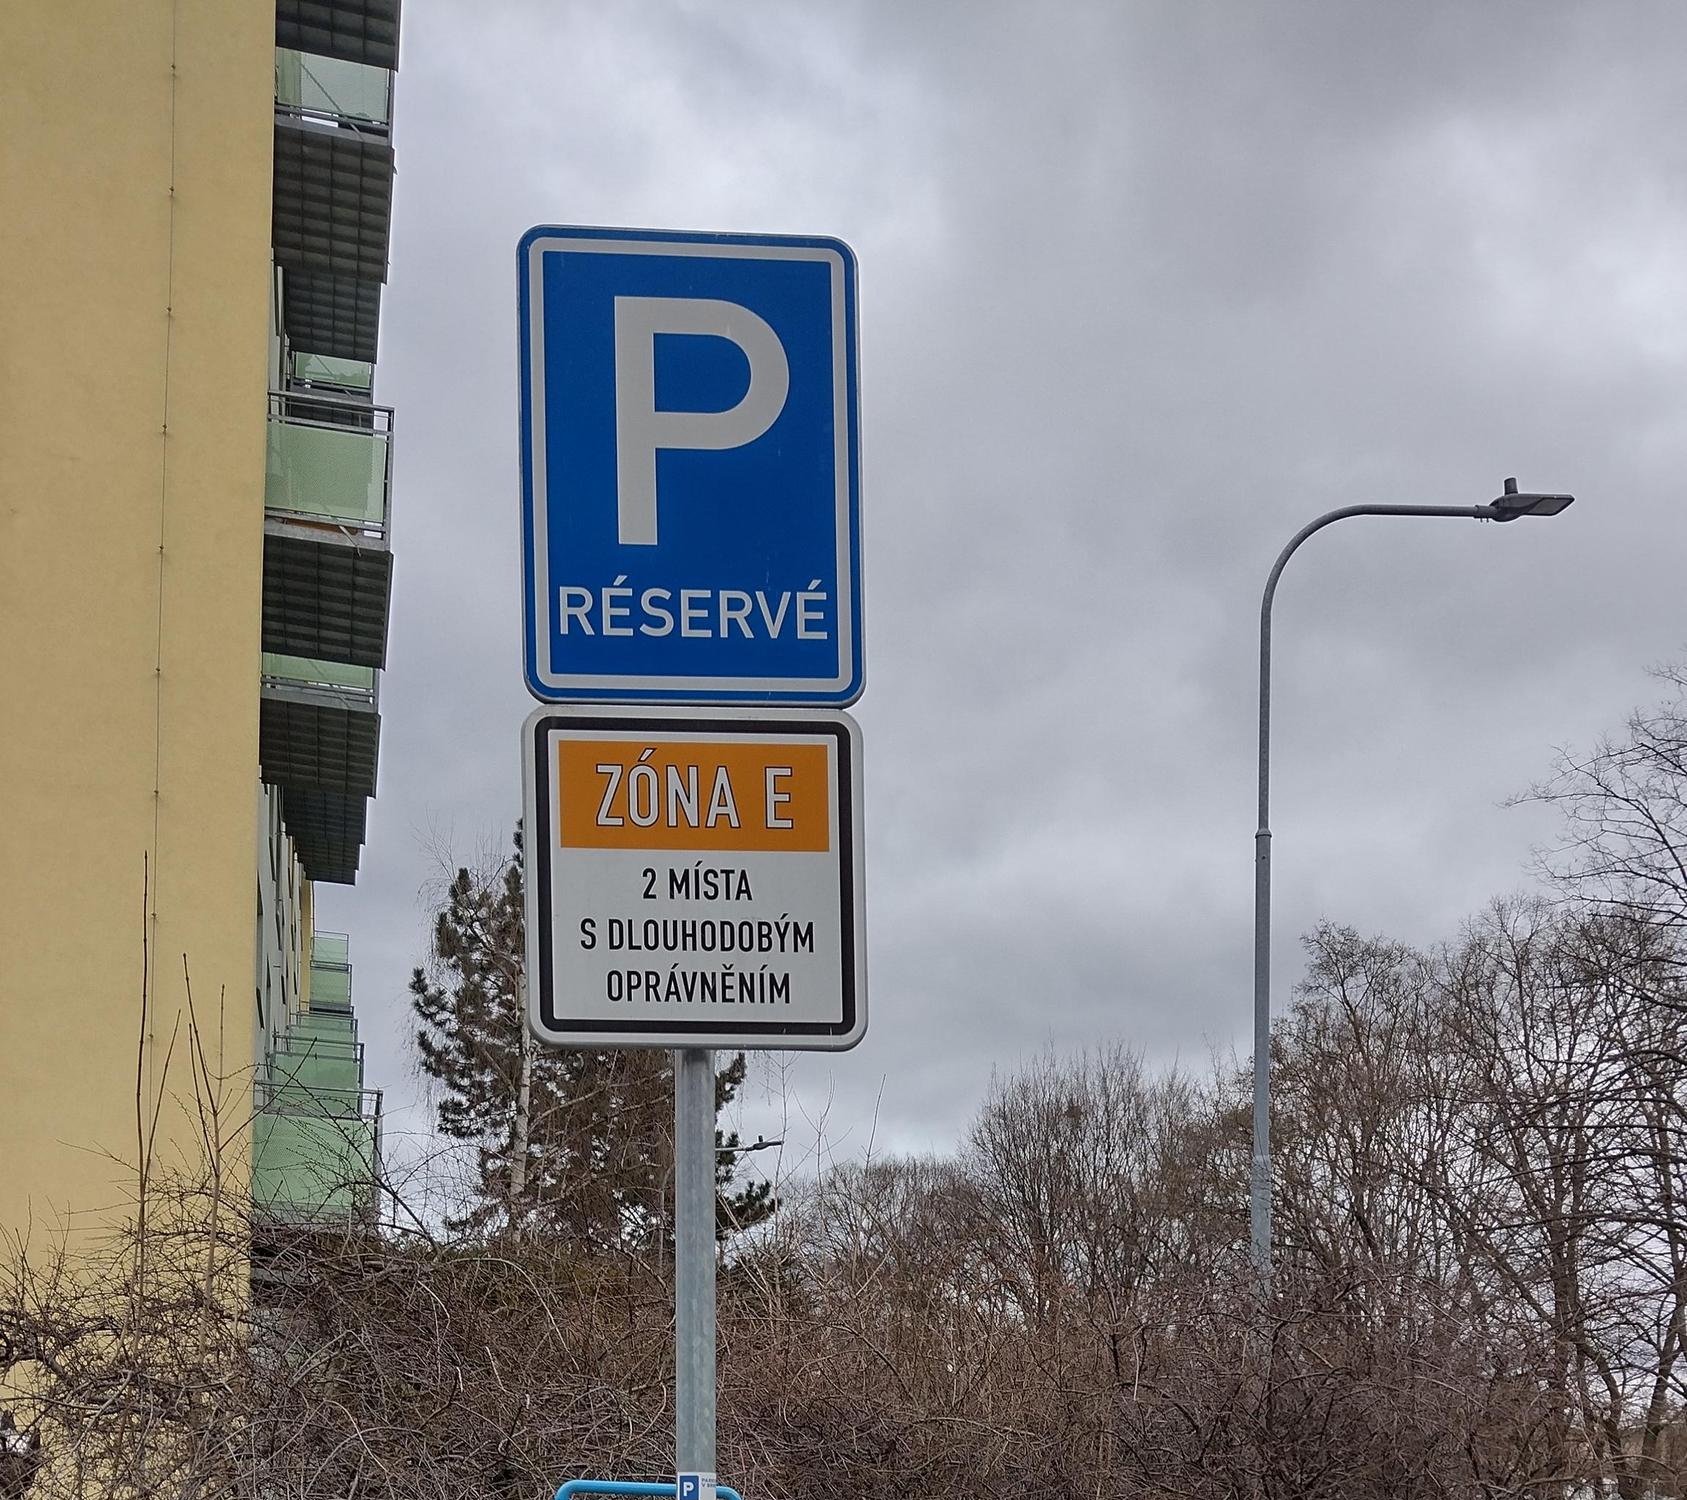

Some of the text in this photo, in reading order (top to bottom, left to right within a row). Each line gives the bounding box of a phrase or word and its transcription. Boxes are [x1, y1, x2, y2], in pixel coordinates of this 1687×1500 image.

[614, 296, 789, 545] P
[559, 575, 828, 640] RÉSERVÉ
[596, 747, 794, 829] ZÓNA E
[642, 860, 753, 901] 2 MÍSTA
[580, 912, 815, 953] S DLOUHODOBÝM
[606, 962, 791, 1004] OPRÁVNĚNÍM
[683, 1481, 695, 1497] P
